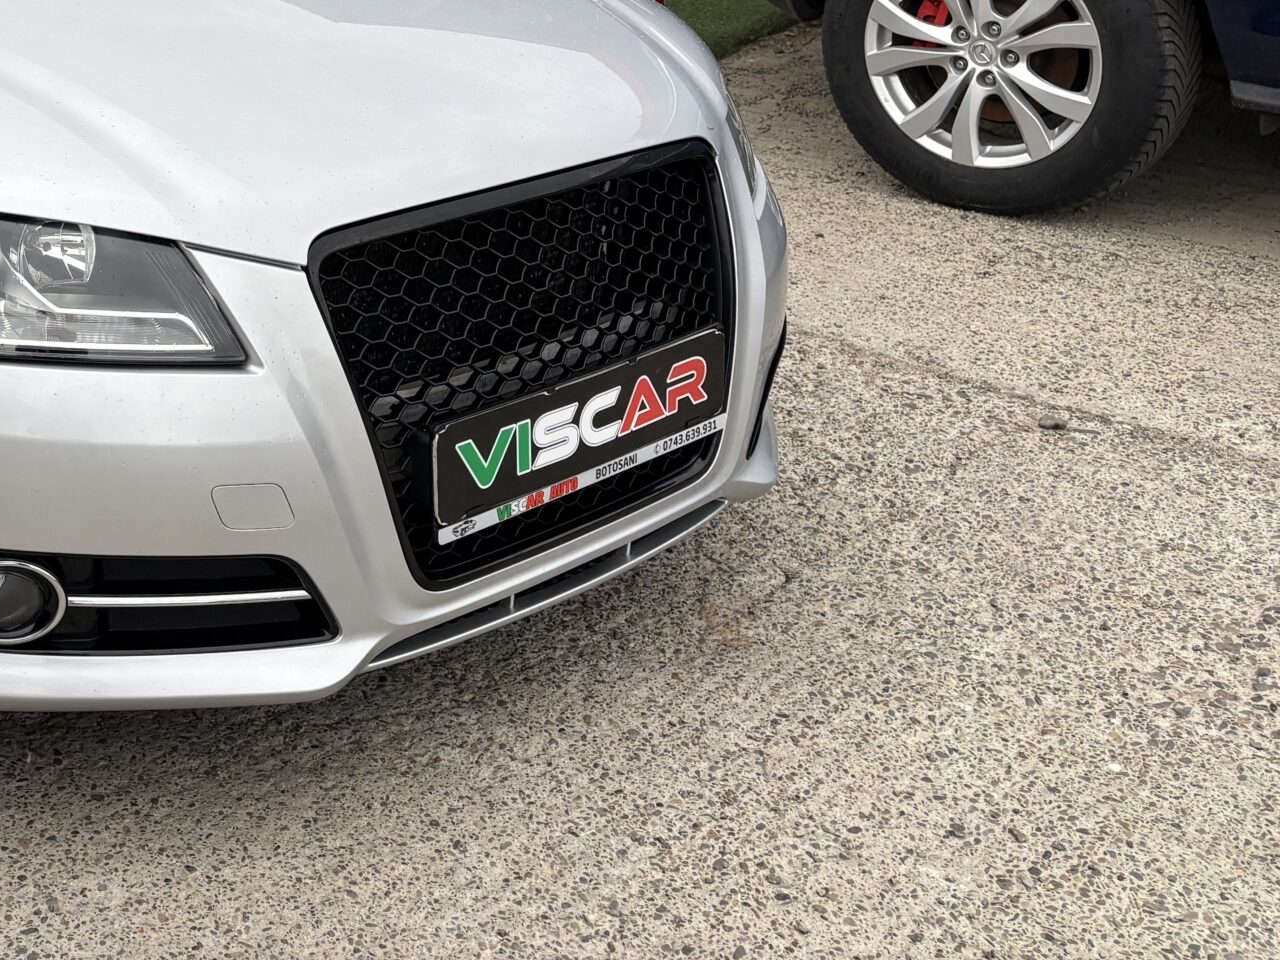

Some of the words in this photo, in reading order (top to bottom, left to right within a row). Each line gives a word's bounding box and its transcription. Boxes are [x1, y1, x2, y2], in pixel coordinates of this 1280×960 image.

[455, 355, 708, 490] VISCAR
[496, 491, 545, 522] VISCAR
[549, 476, 579, 500] AUTO
[595, 453, 638, 480] BOTOSANI
[663, 420, 717, 452] 0743.639.931
